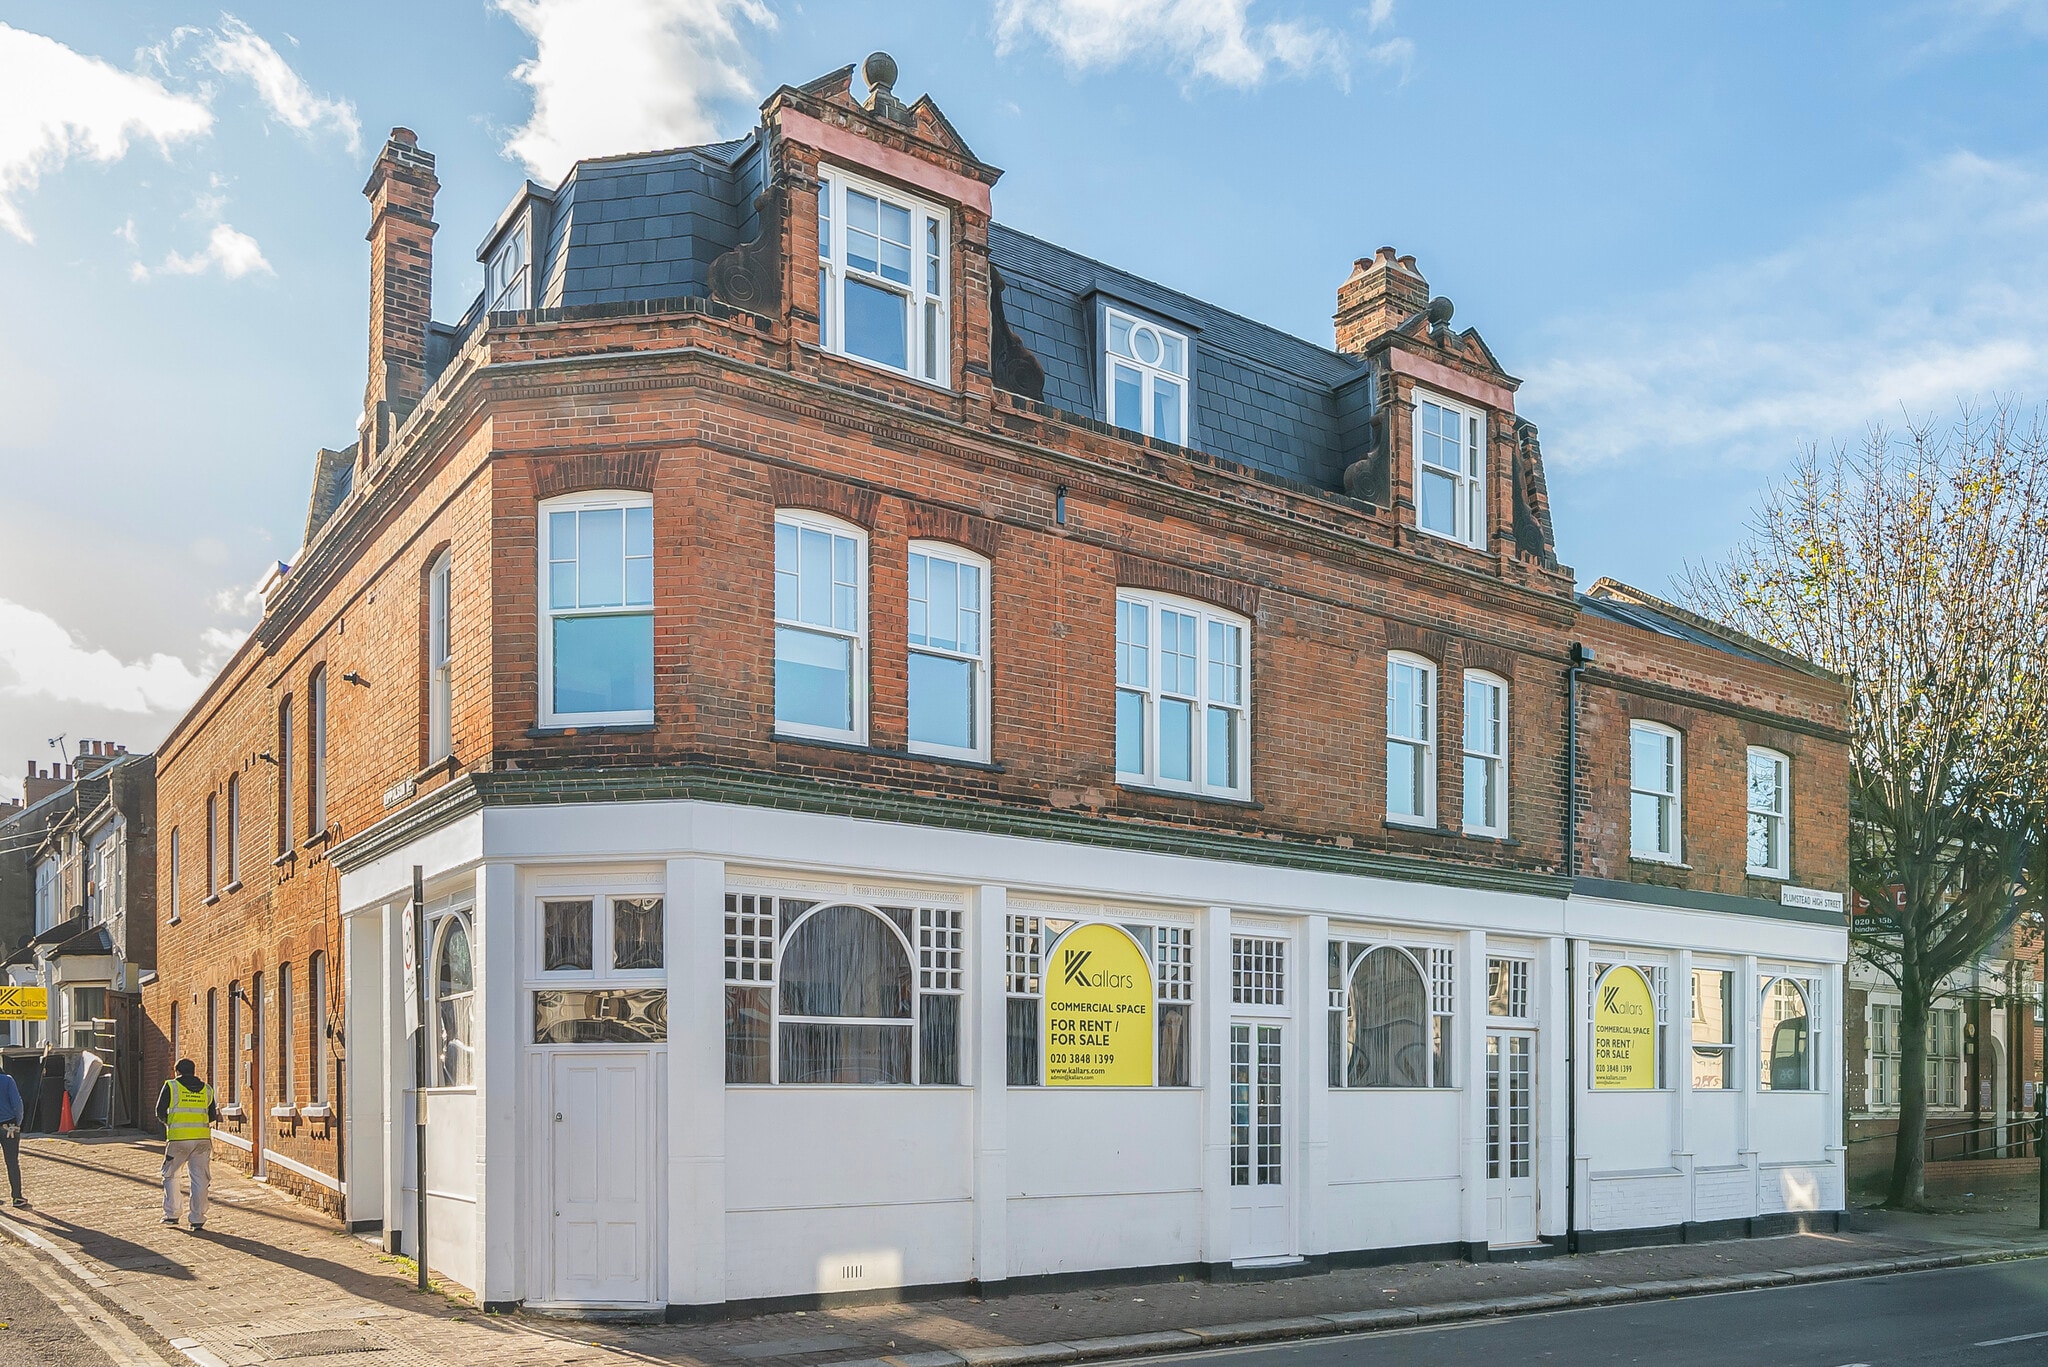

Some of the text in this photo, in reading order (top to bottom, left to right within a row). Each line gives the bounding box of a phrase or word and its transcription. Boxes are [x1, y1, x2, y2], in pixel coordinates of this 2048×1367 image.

[1783, 893, 1811, 905] PLUMSTEAD
[1812, 897, 1823, 906] HIGH
[1824, 899, 1841, 909] STREET
[1064, 949, 1134, 989] Kallars
[0, 989, 47, 1007] Kallars
[1603, 985, 1643, 1016] Kallars
[1050, 1001, 1146, 1014] COMMERCIAL SPACE
[1050, 1019, 1119, 1032] FOR RENT /
[1596, 1025, 1650, 1035] COMMERCIAL SPACE
[1050, 1033, 1110, 1046] FOR SALE
[1596, 1038, 1611, 1048] FOR
[1611, 1038, 1631, 1049] RENT
[1050, 1053, 1115, 1064] 020 3848 1399
[1596, 1049, 1630, 1059] FOR SALE
[1050, 1066, 1106, 1075] www.kallars.com
[1596, 1064, 1632, 1073] 020 3848 1399
